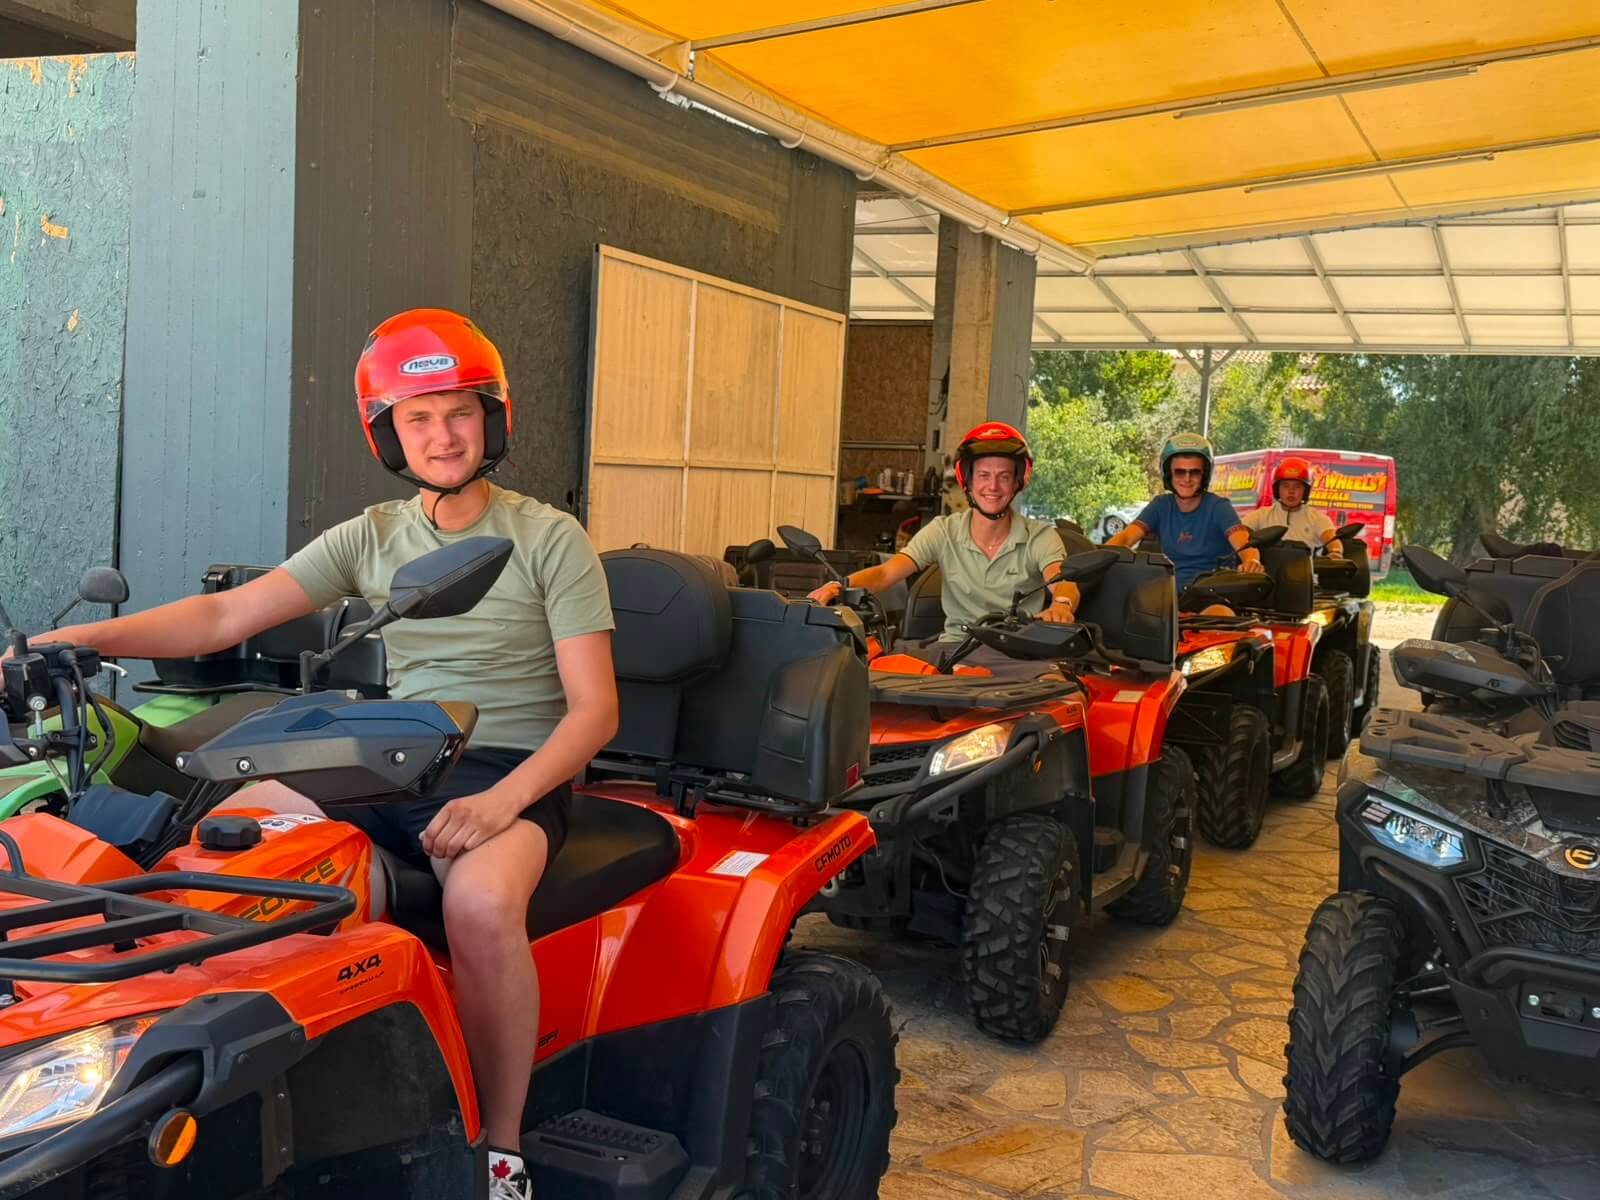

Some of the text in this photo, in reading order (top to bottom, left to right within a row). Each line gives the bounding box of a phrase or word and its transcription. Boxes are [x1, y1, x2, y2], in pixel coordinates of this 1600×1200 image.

[1325, 472, 1378, 492] WHEELS
[815, 835, 852, 873] CFMOTO
[239, 856, 337, 920] FOCE
